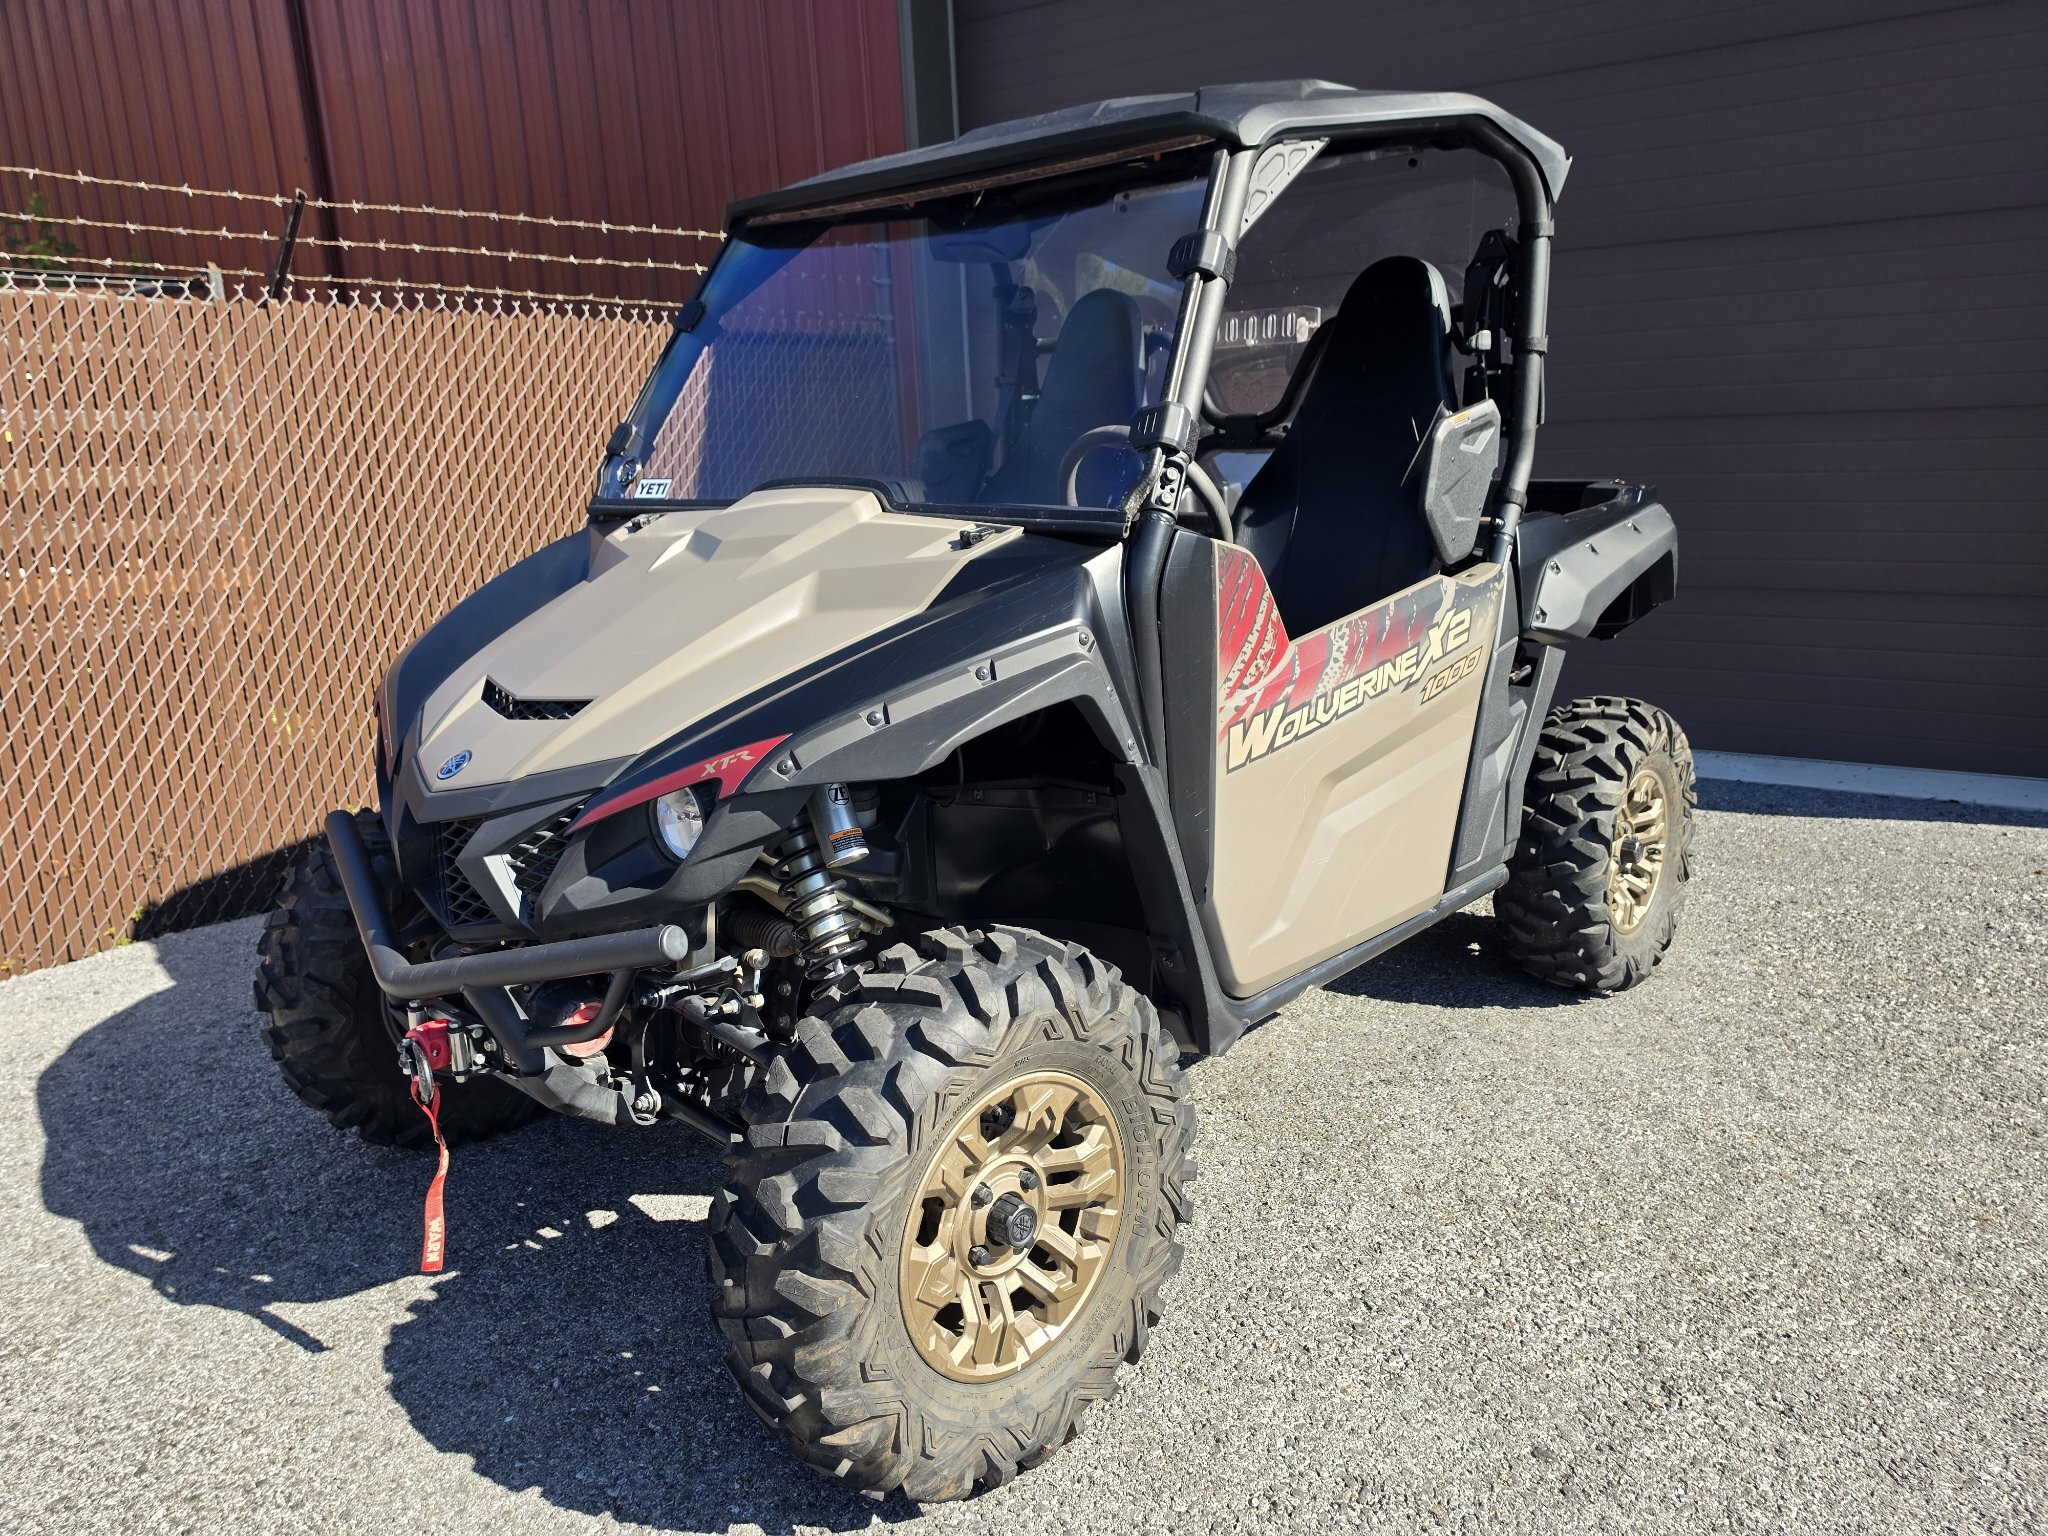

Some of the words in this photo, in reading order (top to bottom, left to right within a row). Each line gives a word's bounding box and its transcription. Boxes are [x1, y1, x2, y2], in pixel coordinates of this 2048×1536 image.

[639, 482, 668, 496] YETI
[1226, 646, 1421, 773] WOLVERINE
[1405, 607, 1472, 688] X2
[1420, 646, 1484, 705] 1000
[700, 750, 756, 778] XT-R
[829, 785, 849, 802] ZF
[425, 1216, 442, 1263] WARN
